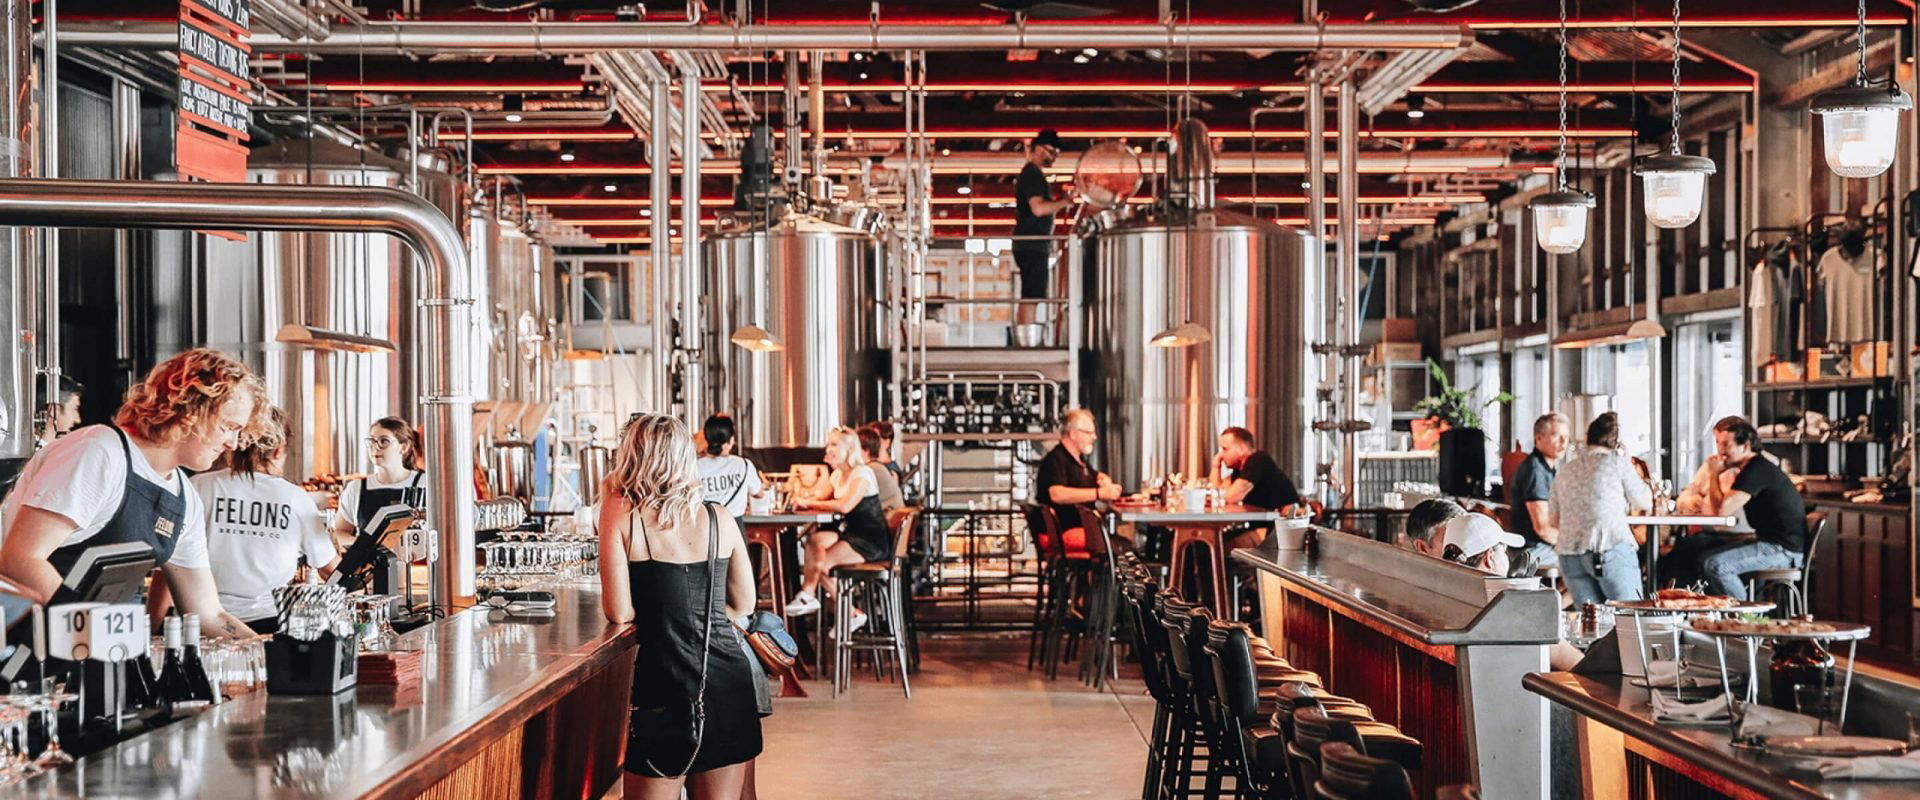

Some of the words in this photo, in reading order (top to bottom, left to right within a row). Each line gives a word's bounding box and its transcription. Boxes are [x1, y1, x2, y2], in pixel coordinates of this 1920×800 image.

[701, 473, 742, 492] ELONS
[215, 497, 292, 530] FELONS
[219, 528, 265, 537] BREWING
[62, 611, 90, 633] 10
[104, 611, 134, 634] 121
